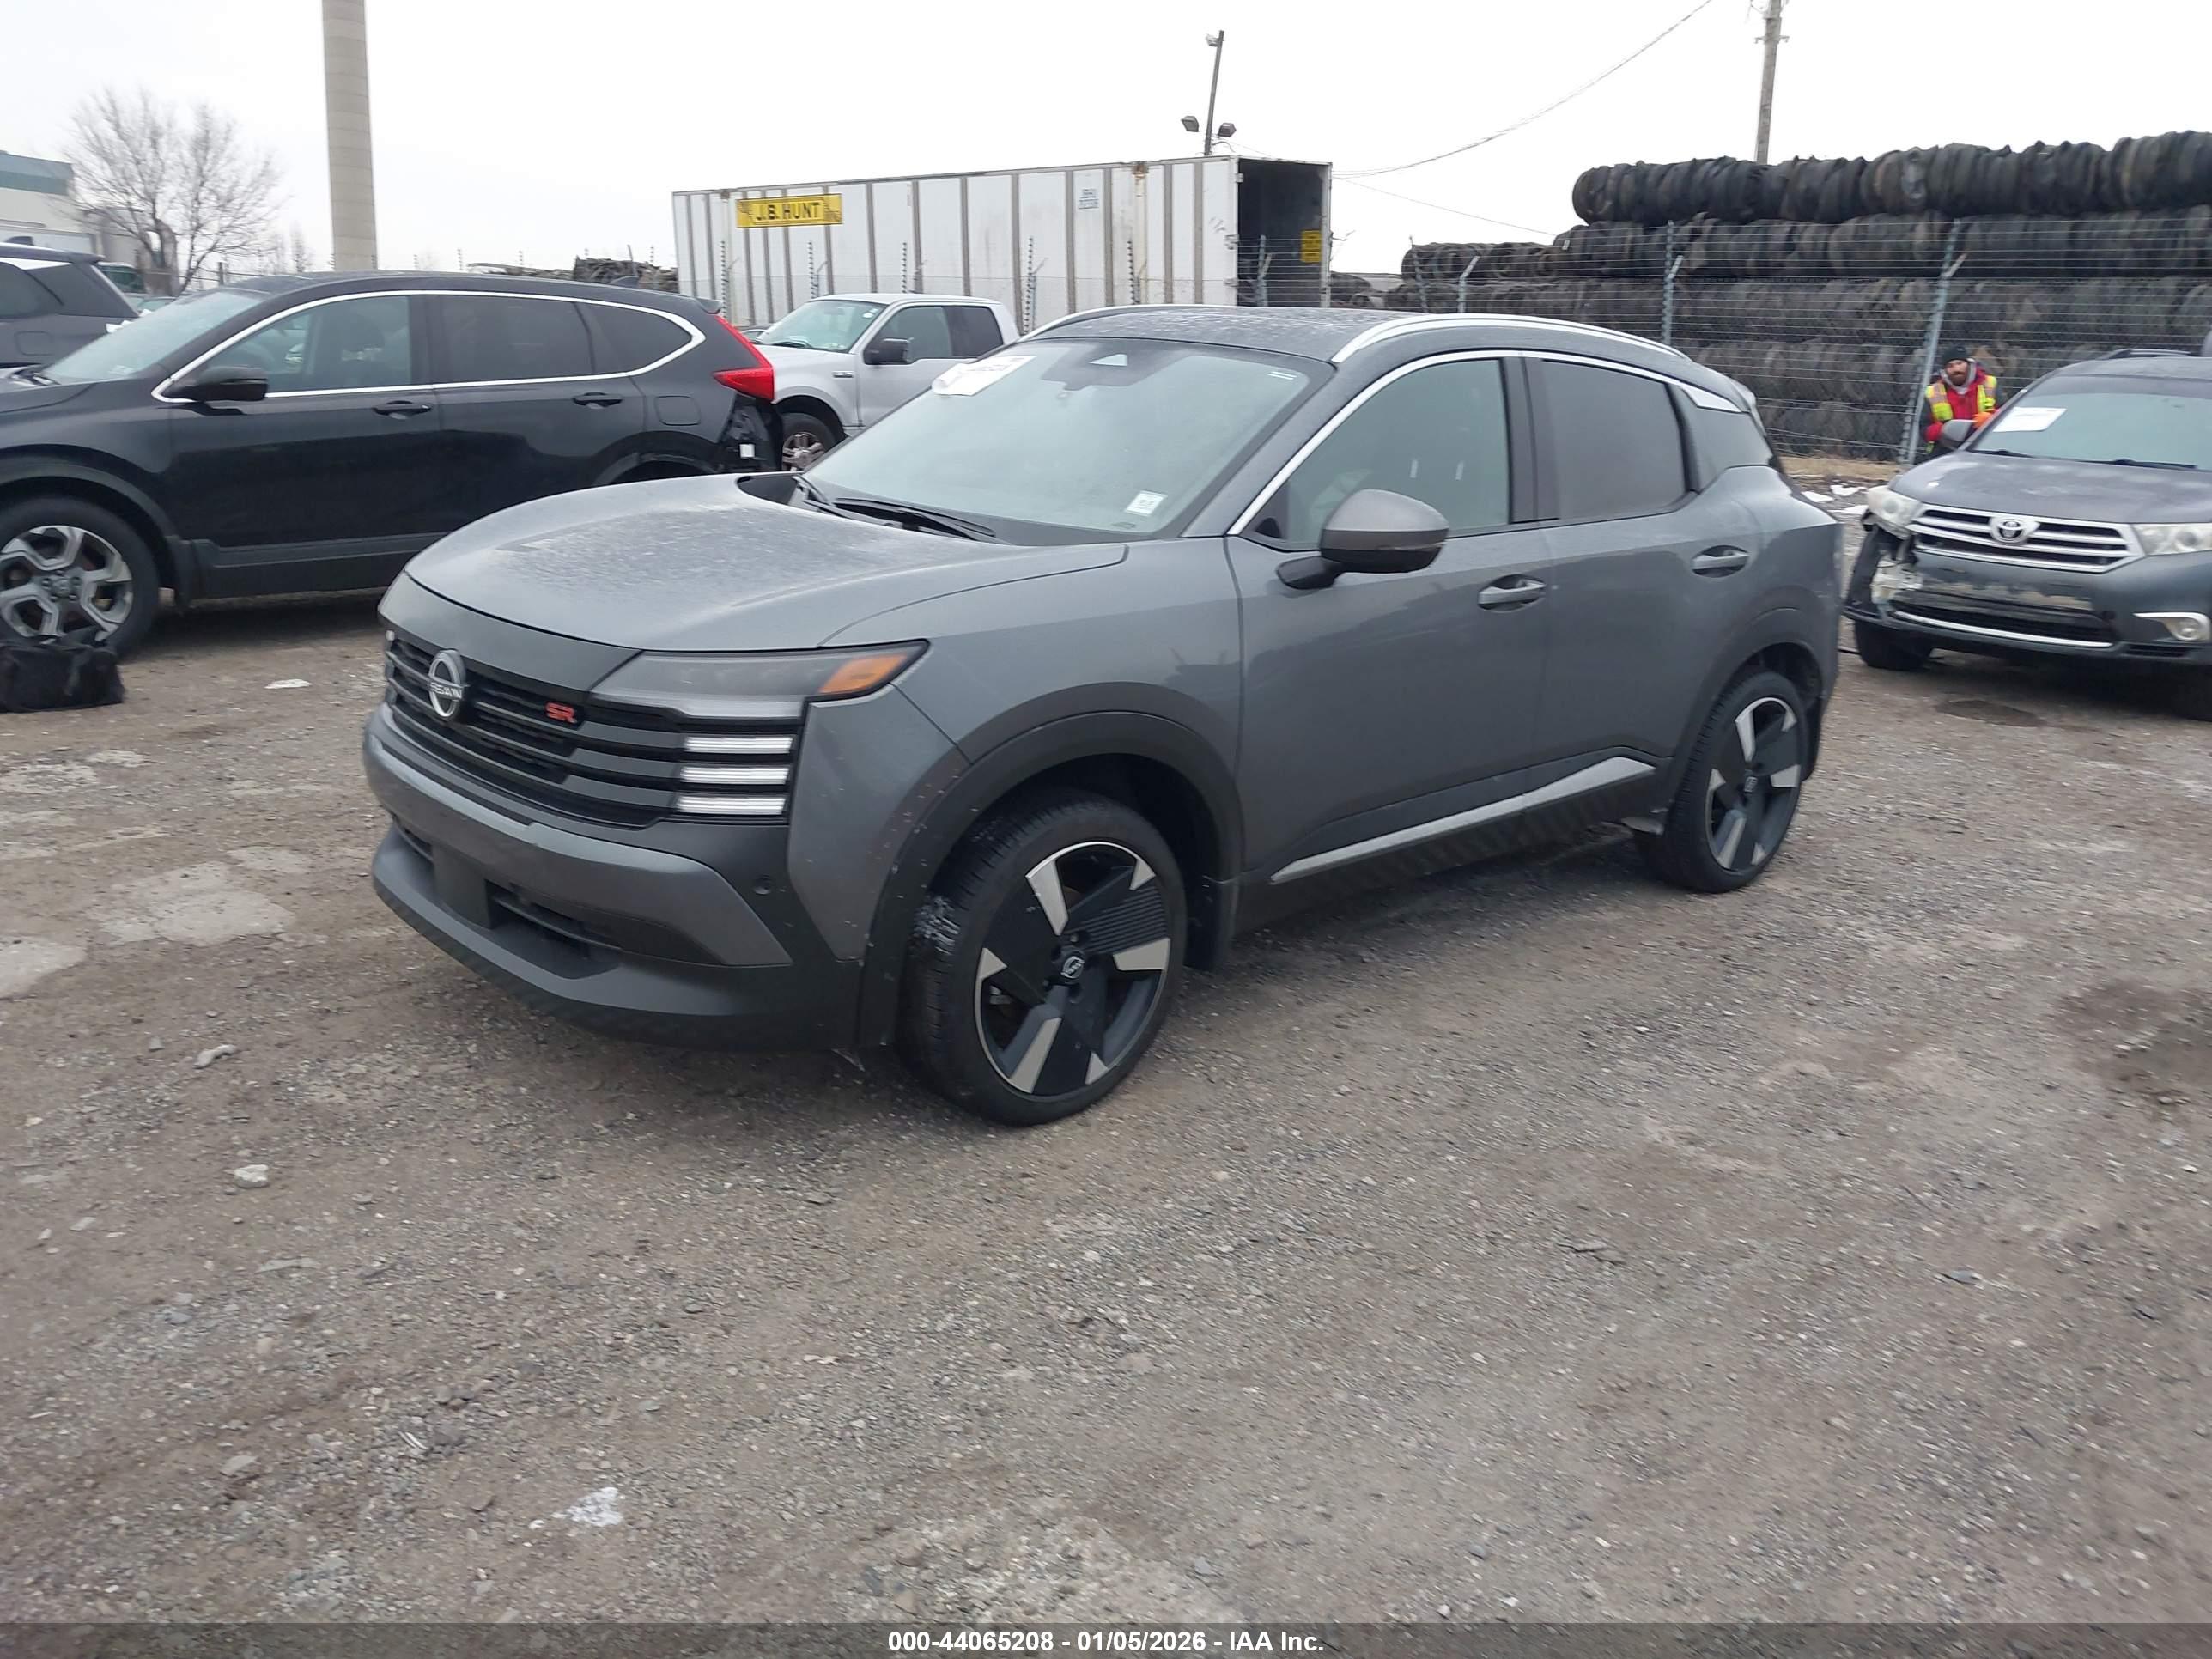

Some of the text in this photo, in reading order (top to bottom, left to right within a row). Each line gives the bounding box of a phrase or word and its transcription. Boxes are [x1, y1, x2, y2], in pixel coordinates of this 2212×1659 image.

[756, 202, 820, 221] J.B. HUNT
[544, 702, 577, 723] SR
